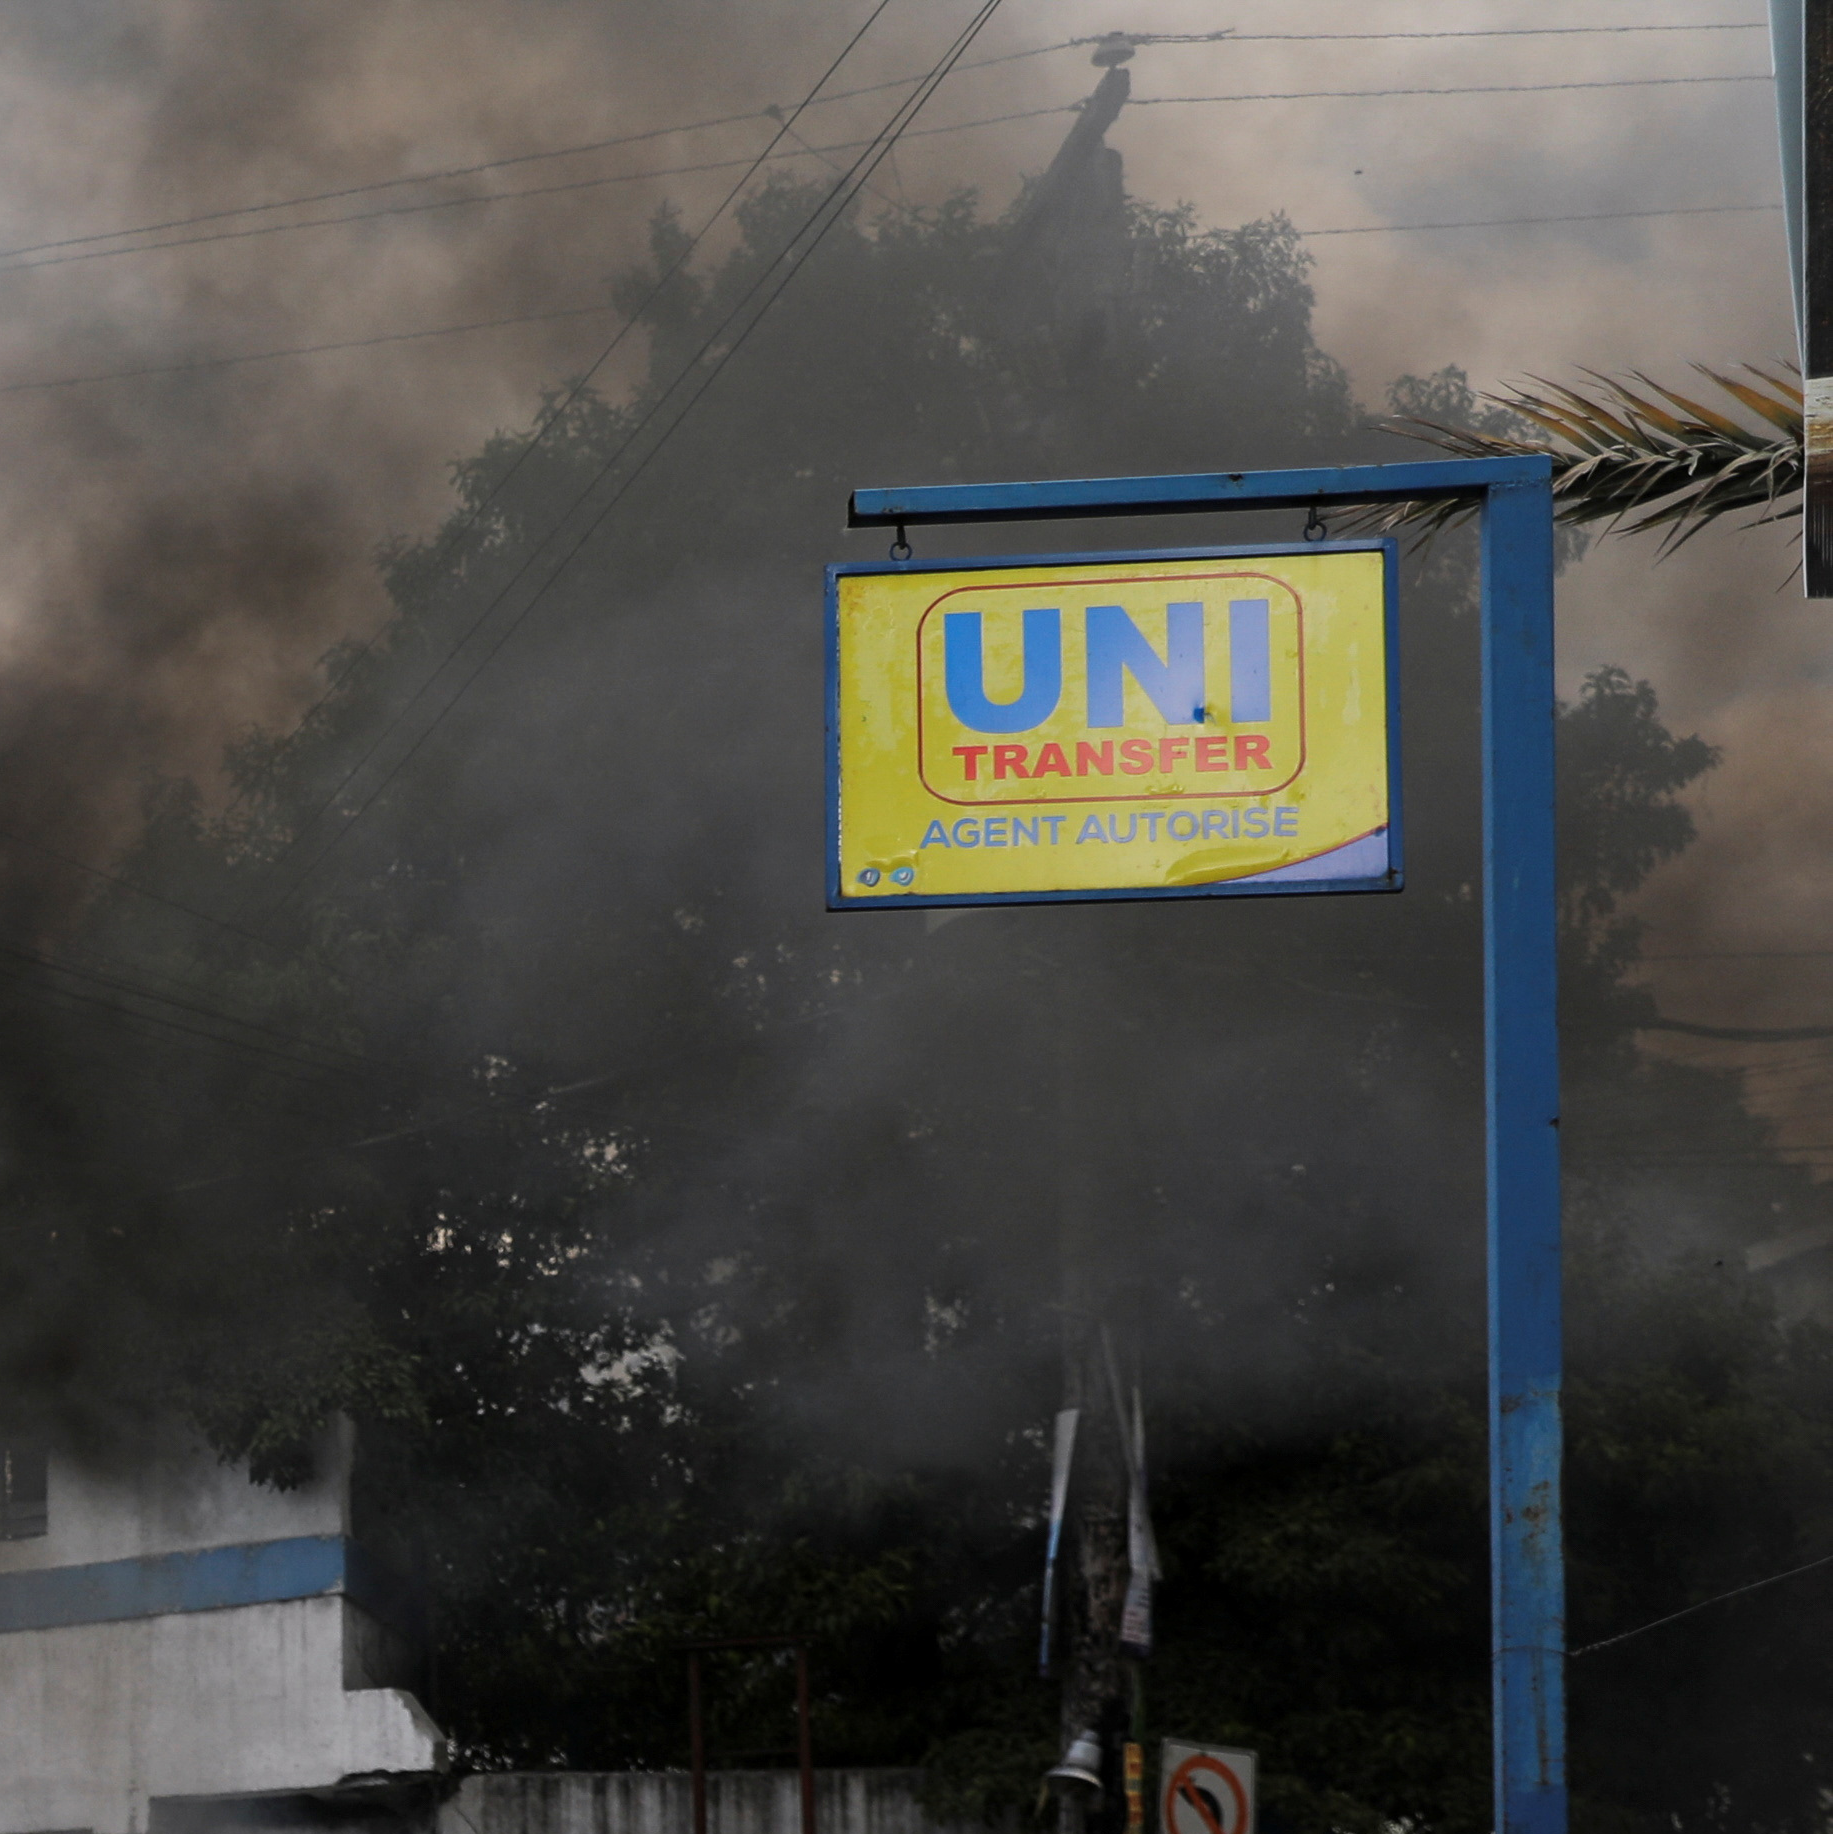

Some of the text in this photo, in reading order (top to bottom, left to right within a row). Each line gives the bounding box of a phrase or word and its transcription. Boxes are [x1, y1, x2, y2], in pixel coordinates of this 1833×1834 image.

[944, 599, 1271, 734] UNI
[952, 734, 1273, 781] TRANSFER
[919, 806, 1300, 849] AGENT AUTORISE
